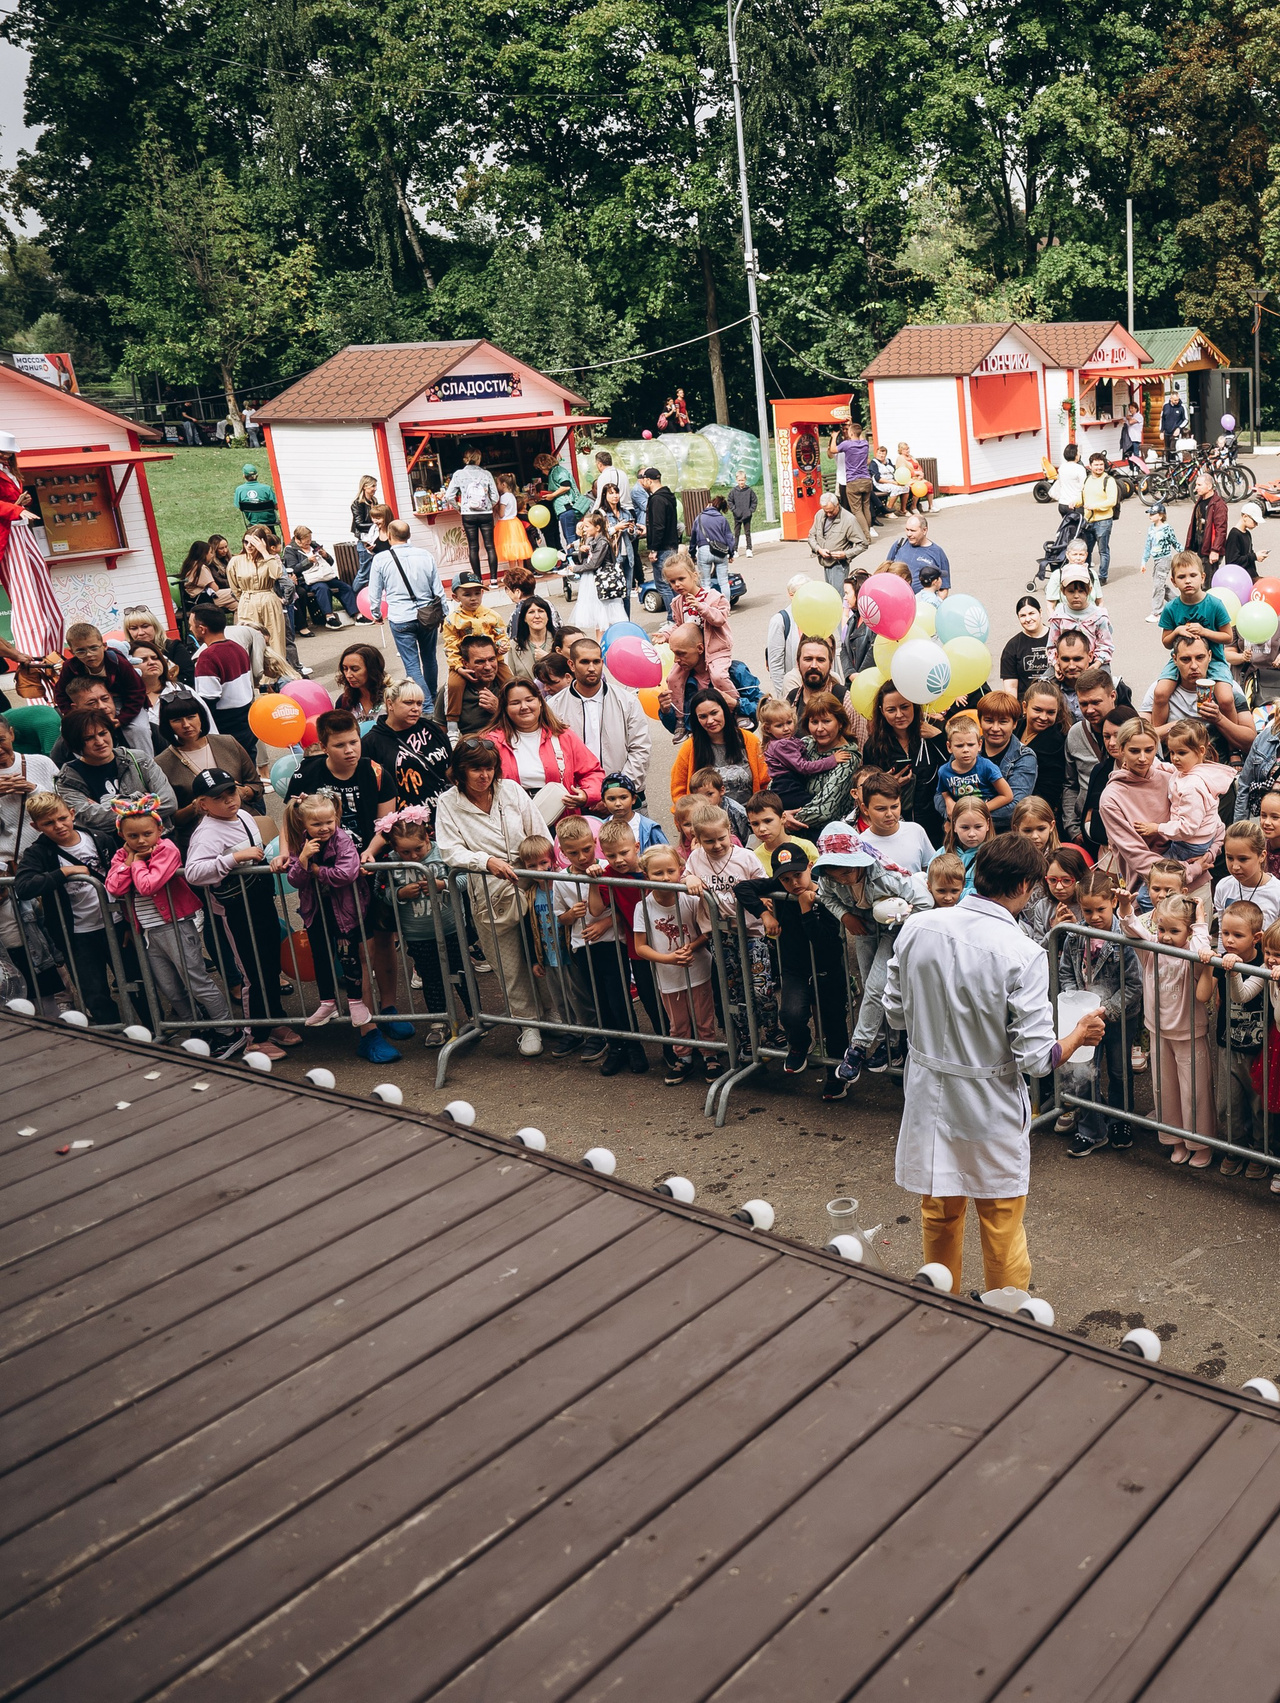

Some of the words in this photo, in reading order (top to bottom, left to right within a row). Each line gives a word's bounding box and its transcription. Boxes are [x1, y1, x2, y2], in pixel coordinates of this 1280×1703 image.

[980, 353, 1031, 372] ПОНЧИКИ
[441, 379, 508, 396] СЛАДОСТИ
[777, 428, 790, 470] ROCKY
[782, 470, 795, 513] BOXER
